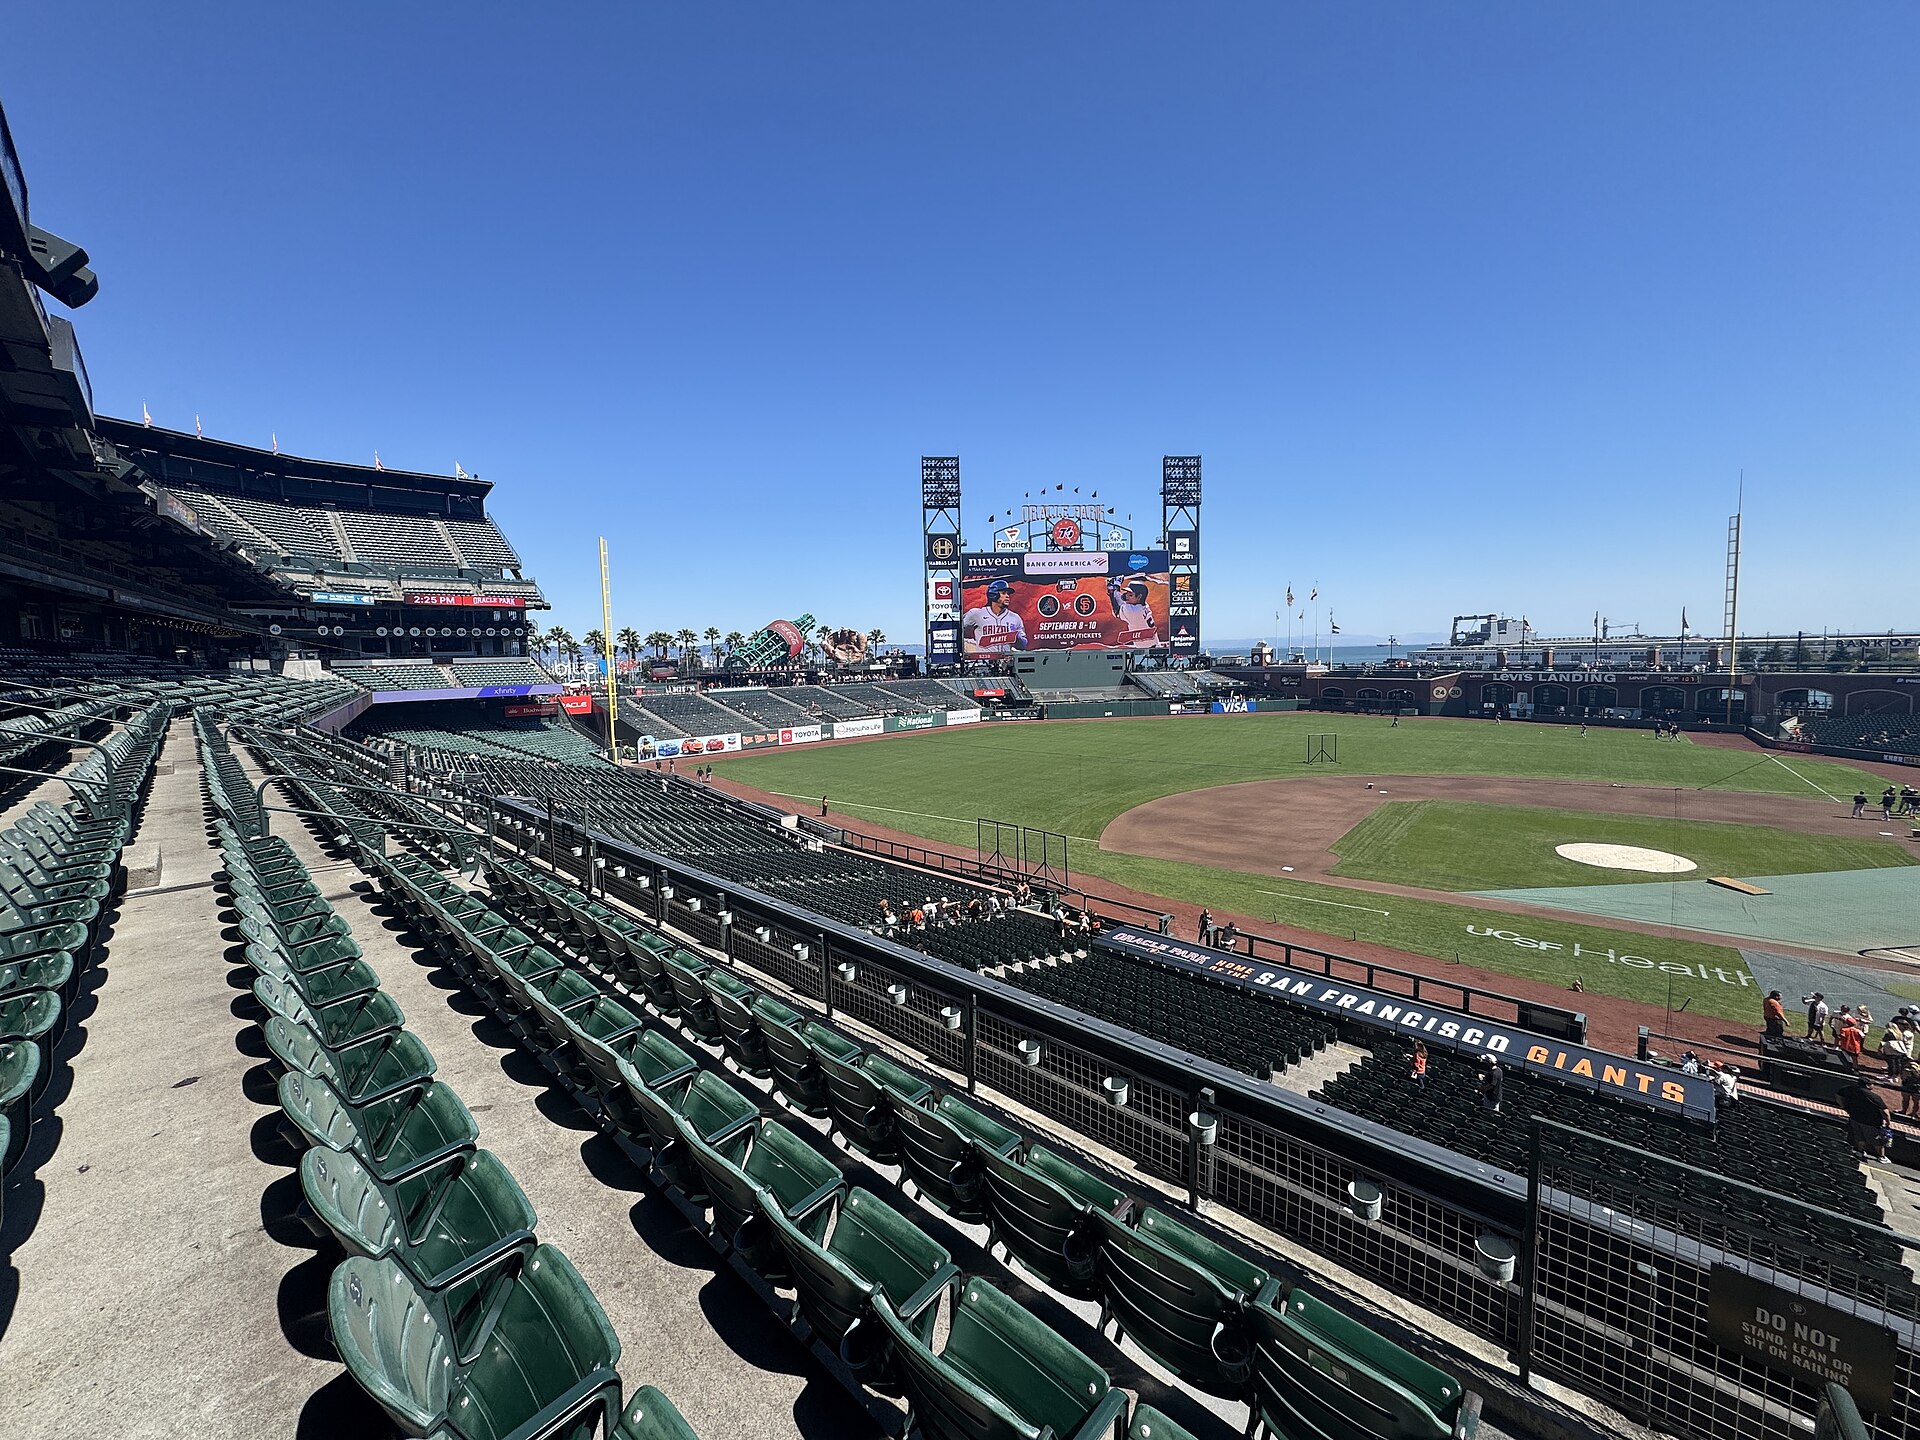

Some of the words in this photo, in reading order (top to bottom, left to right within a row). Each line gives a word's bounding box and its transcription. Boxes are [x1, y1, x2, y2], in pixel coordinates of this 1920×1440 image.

[1021, 505, 1069, 522] ORACLE
[1074, 505, 1105, 522] PARK
[996, 540, 1029, 549] Fanatics
[968, 557, 1019, 566] nuveen
[413, 595, 437, 604] 2:25
[440, 595, 455, 604] PM
[473, 596, 497, 604] ORACLE
[498, 597, 516, 605] PARK
[1039, 622, 1078, 631] SEPTEMBER
[1033, 632, 1102, 640] SFGIANTS.COM/TICKETS
[1836, 639, 1884, 647] BANK
[1890, 639, 1912, 647] OF
[1538, 673, 1617, 682] LANDING
[494, 687, 517, 695] xfinity
[1221, 702, 1248, 712] VISA
[906, 715, 933, 726] National
[794, 730, 820, 739] TOYOTA
[1465, 924, 1564, 951] UCSF
[1112, 932, 1170, 951] ORACLE
[1168, 946, 1211, 965] PARK
[1215, 959, 1256, 975] HOME
[1208, 965, 1225, 974] OF
[1225, 970, 1250, 980] THE
[1253, 972, 1315, 996] SAN
[1318, 989, 1511, 1053] FRANCISCO
[1525, 1045, 1685, 1104] GIANTS
[1755, 1306, 1787, 1332] DO
[1794, 1321, 1841, 1353] NOT
[1741, 1321, 1788, 1349] STAND,
[1792, 1342, 1828, 1365] LEAN
[1832, 1358, 1853, 1375] OR
[1743, 1335, 1765, 1352] SIT
[1769, 1346, 1788, 1360] ON
[1792, 1355, 1850, 1387] RAILING
